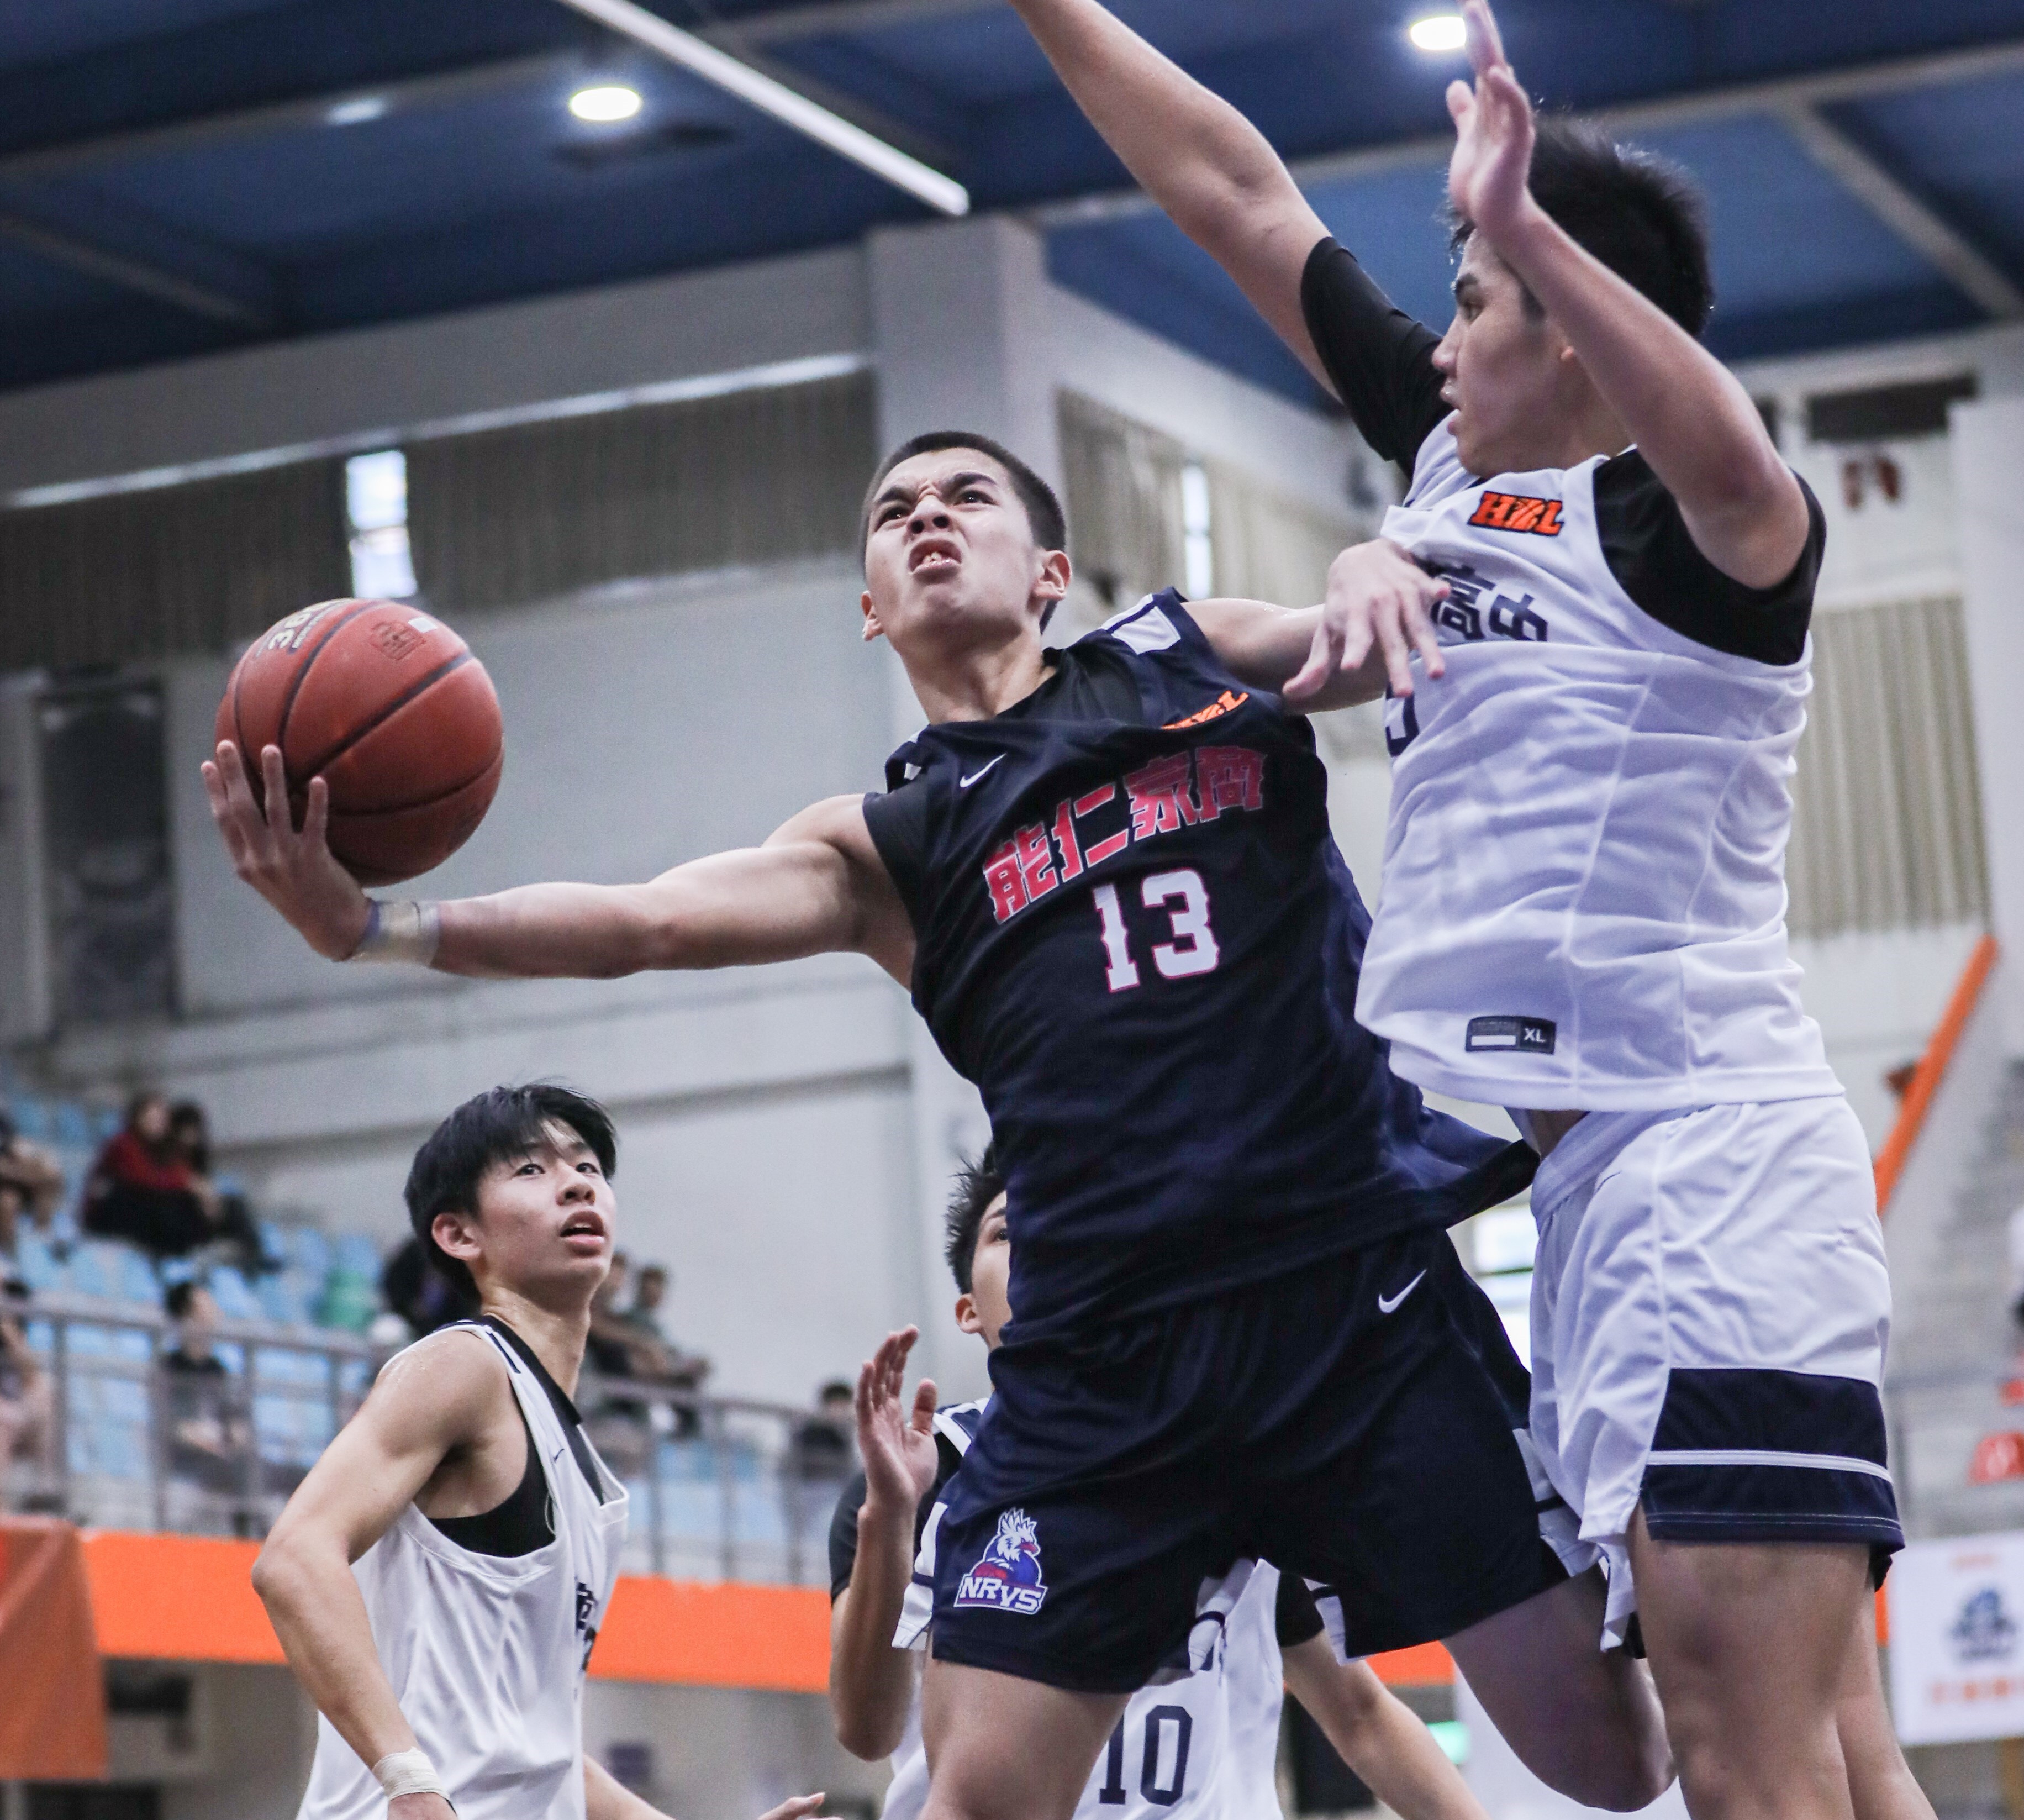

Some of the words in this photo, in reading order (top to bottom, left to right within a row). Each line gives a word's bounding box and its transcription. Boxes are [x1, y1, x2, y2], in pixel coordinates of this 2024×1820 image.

[1093, 867, 1219, 992] 13
[1524, 1027, 1546, 1043] XL
[960, 1577, 1042, 1612] NRVS
[1099, 1706, 1192, 1807] 10
